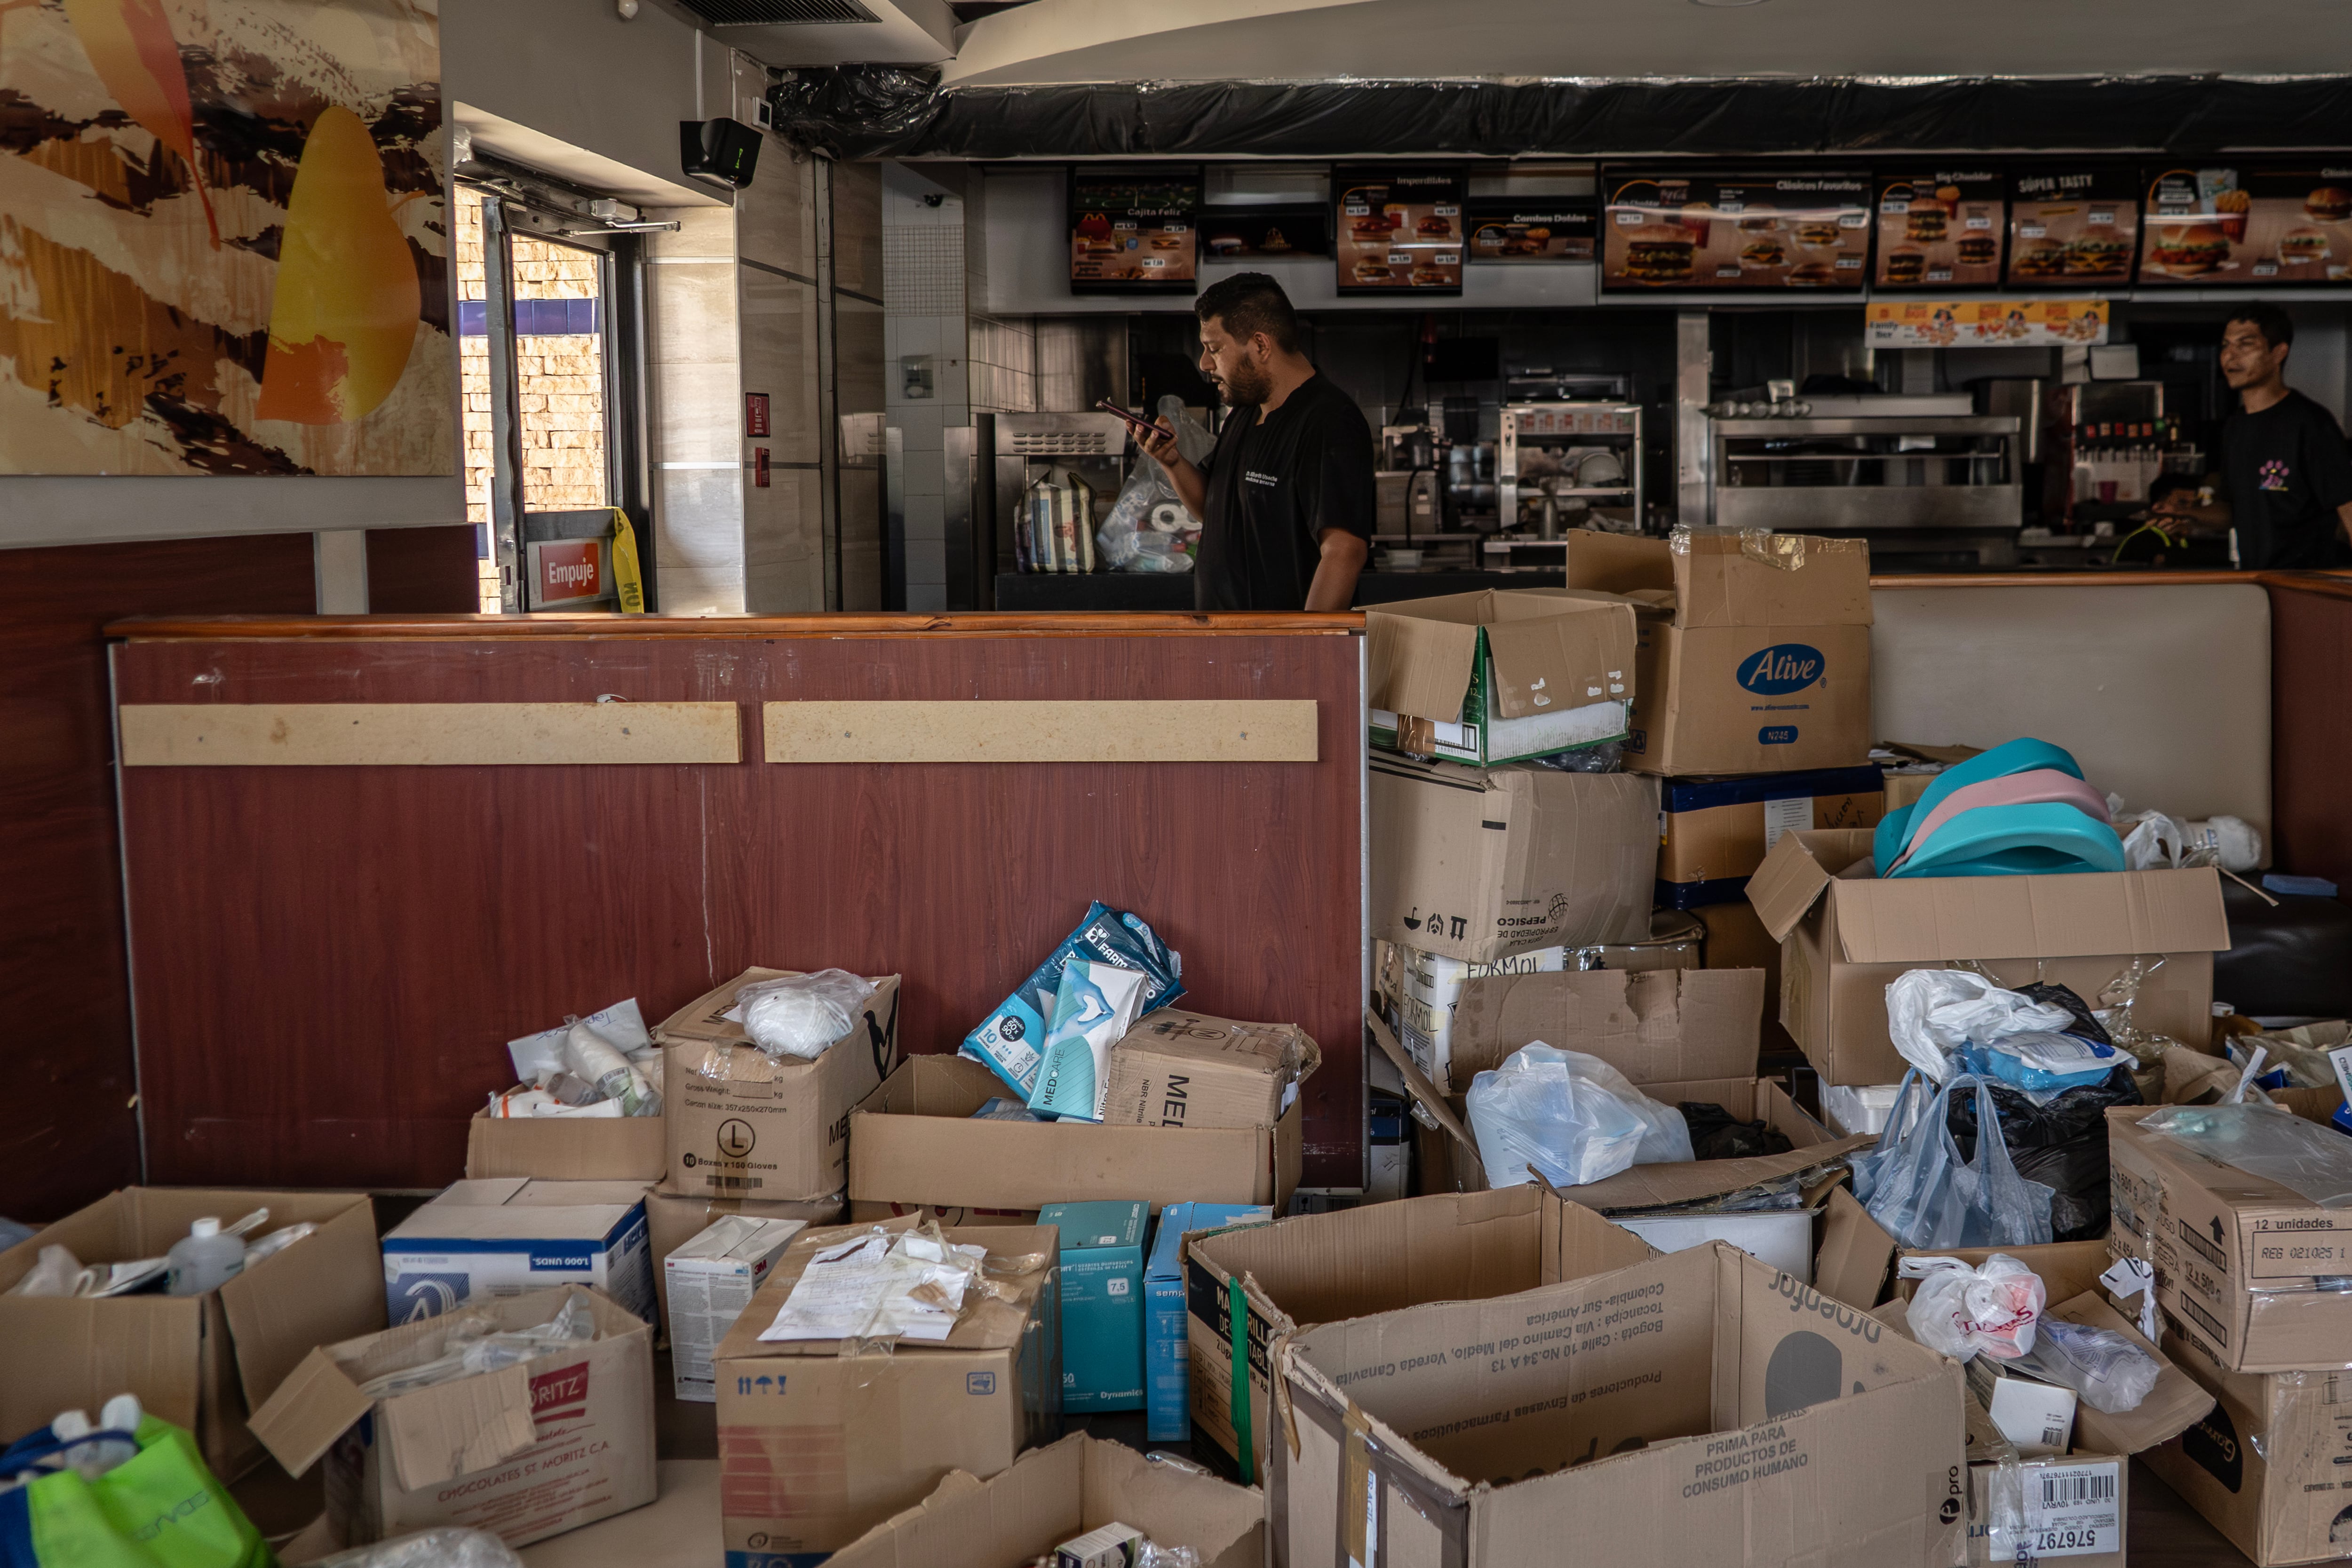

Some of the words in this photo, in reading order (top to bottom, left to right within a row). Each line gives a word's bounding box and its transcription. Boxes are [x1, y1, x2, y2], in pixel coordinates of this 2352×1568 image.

[2058, 174, 2093, 188] TASTY
[1128, 208, 1157, 218] Cajita
[1159, 208, 1181, 216] Feliz
[1513, 214, 1553, 223] Combos
[548, 557, 594, 588] Empuje
[1748, 650, 1816, 686] Alive
[1470, 687, 1478, 696] 12
[1767, 731, 1789, 740] N245
[1497, 915, 1547, 926] PEPSICO
[1510, 928, 1550, 938] PROPIEDAD
[1404, 994, 1438, 1032] FORMOL
[1001, 1025, 1011, 1035] 90
[1007, 1020, 1017, 1030] 60
[983, 1028, 997, 1044] 10
[685, 1083, 704, 1092] Gross
[773, 1091, 783, 1099] kg
[1141, 1079, 1150, 1097] NBR
[684, 1098, 706, 1109] Carton
[725, 1104, 787, 1114] 357x250x270mm
[1136, 1099, 1146, 1123] Nitrile
[731, 1124, 744, 1149] L
[698, 1158, 722, 1167] Boxes
[747, 1162, 778, 1170] Gloves
[2255, 1219, 2269, 1230] 12
[2276, 1218, 2334, 1229] unidades
[754, 1258, 767, 1276] 3M
[1110, 1282, 1126, 1292] 7,5
[1582, 1299, 1603, 1314] Sur
[1526, 1305, 1580, 1326] América
[1605, 1302, 1663, 1328] Tocancipá
[1523, 1327, 1572, 1345] Camino
[1621, 1320, 1663, 1341] Bogotá
[1451, 1342, 1495, 1360] Medio,
[1499, 1337, 1519, 1353] del
[1563, 1343, 1578, 1357] 10
[1400, 1353, 1447, 1372] Vereda
[1491, 1359, 1506, 1373] 13
[1511, 1356, 1521, 1369] A
[1336, 1363, 1396, 1386] Canavita
[1590, 1371, 1662, 1399] Productores
[1100, 1388, 1144, 1400] Dynamics
[1571, 1391, 1586, 1404] de
[1706, 1431, 1749, 1457] PRIMA
[1752, 1425, 1787, 1447] PARA
[1694, 1445, 1777, 1478] PRODUCTOS
[1779, 1439, 1797, 1457] DE
[437, 1468, 520, 1503] CHOCOLATES
[542, 1447, 588, 1470] MORITZ
[1682, 1470, 1750, 1499] CONSUMO
[1753, 1454, 1808, 1480] HUMANO
[1948, 1465, 1962, 1495] pro
[2037, 1529, 2095, 1550] 576797
